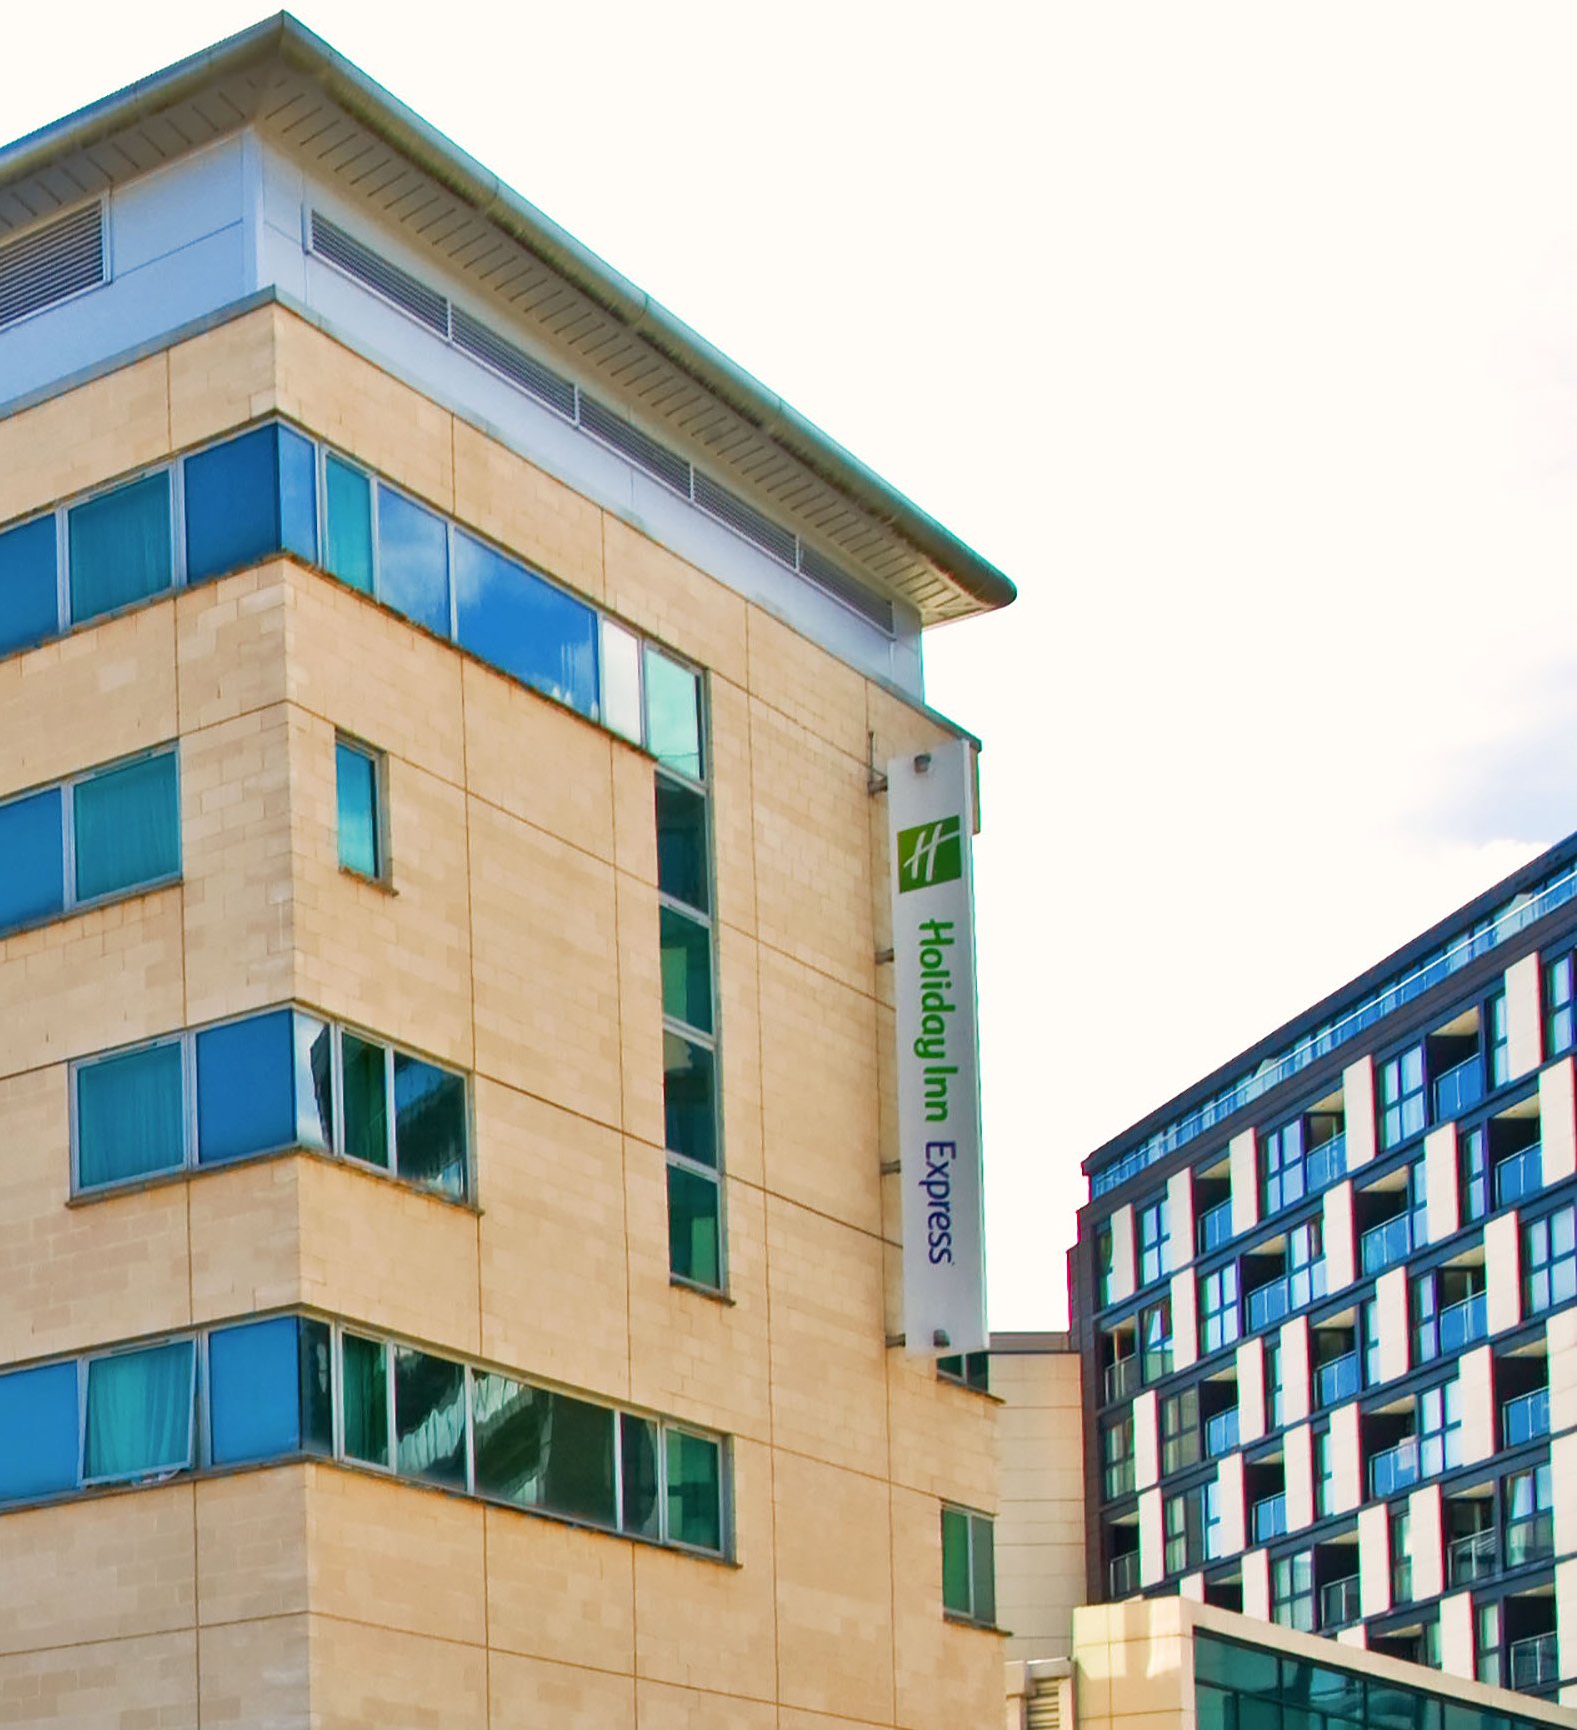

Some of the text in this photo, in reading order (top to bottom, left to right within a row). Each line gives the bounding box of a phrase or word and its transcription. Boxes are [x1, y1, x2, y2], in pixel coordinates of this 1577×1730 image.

[913, 918, 959, 1265] Holiday Inn Express
